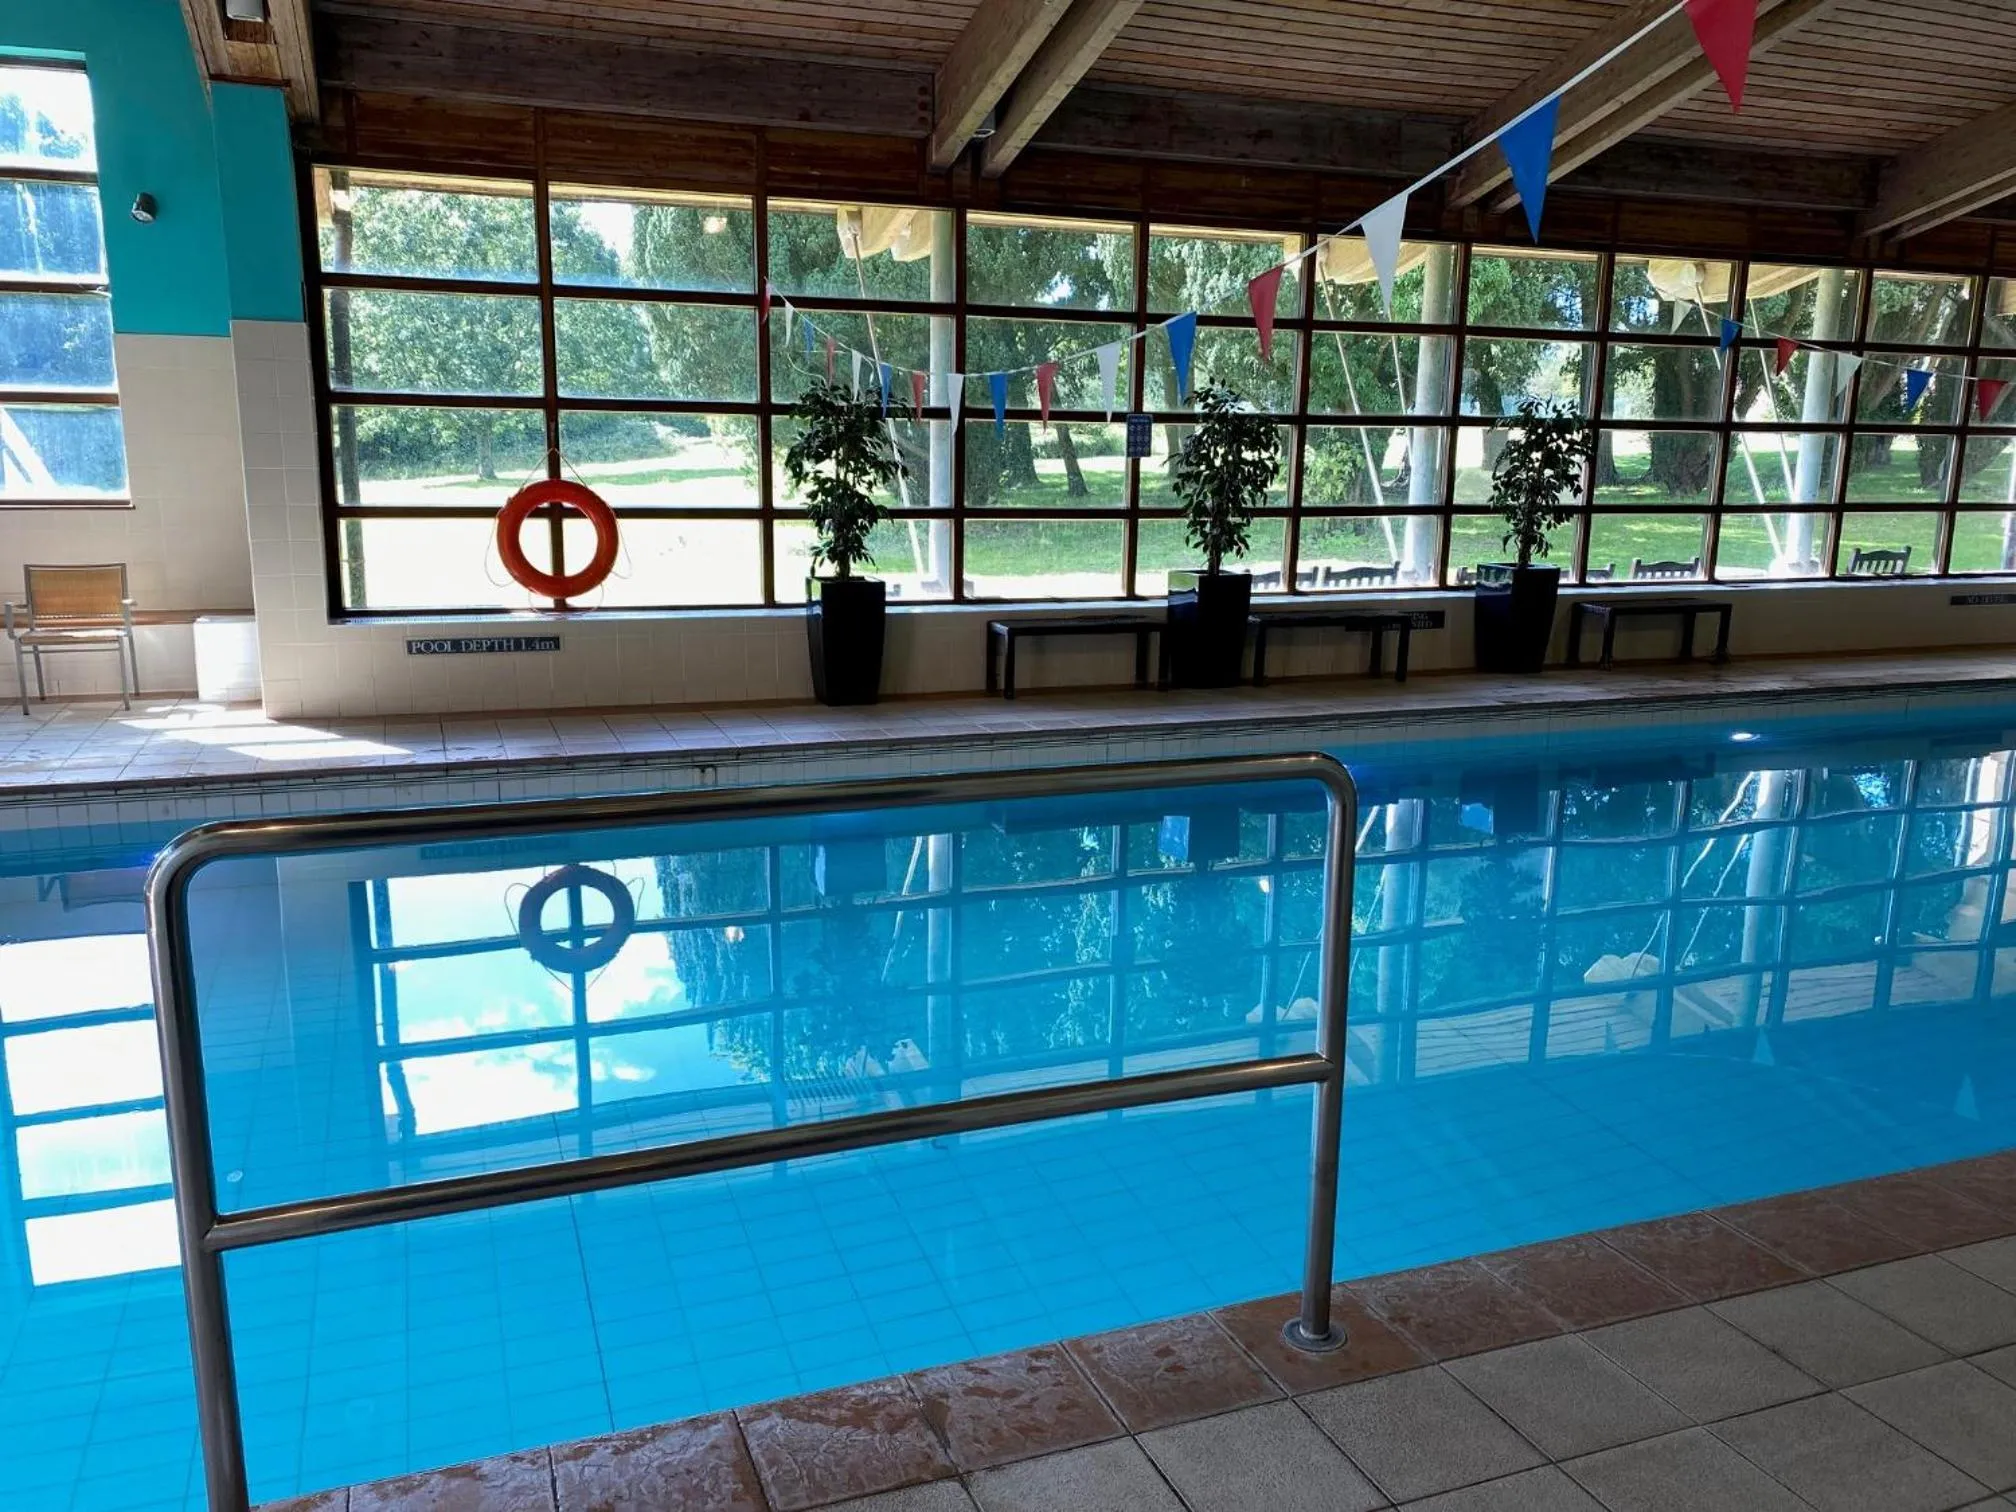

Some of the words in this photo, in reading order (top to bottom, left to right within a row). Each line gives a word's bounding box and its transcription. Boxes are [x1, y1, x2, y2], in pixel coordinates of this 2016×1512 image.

[412, 640, 456, 653] POOL
[461, 639, 514, 652] DEPTH
[521, 638, 555, 650] 1.4m
